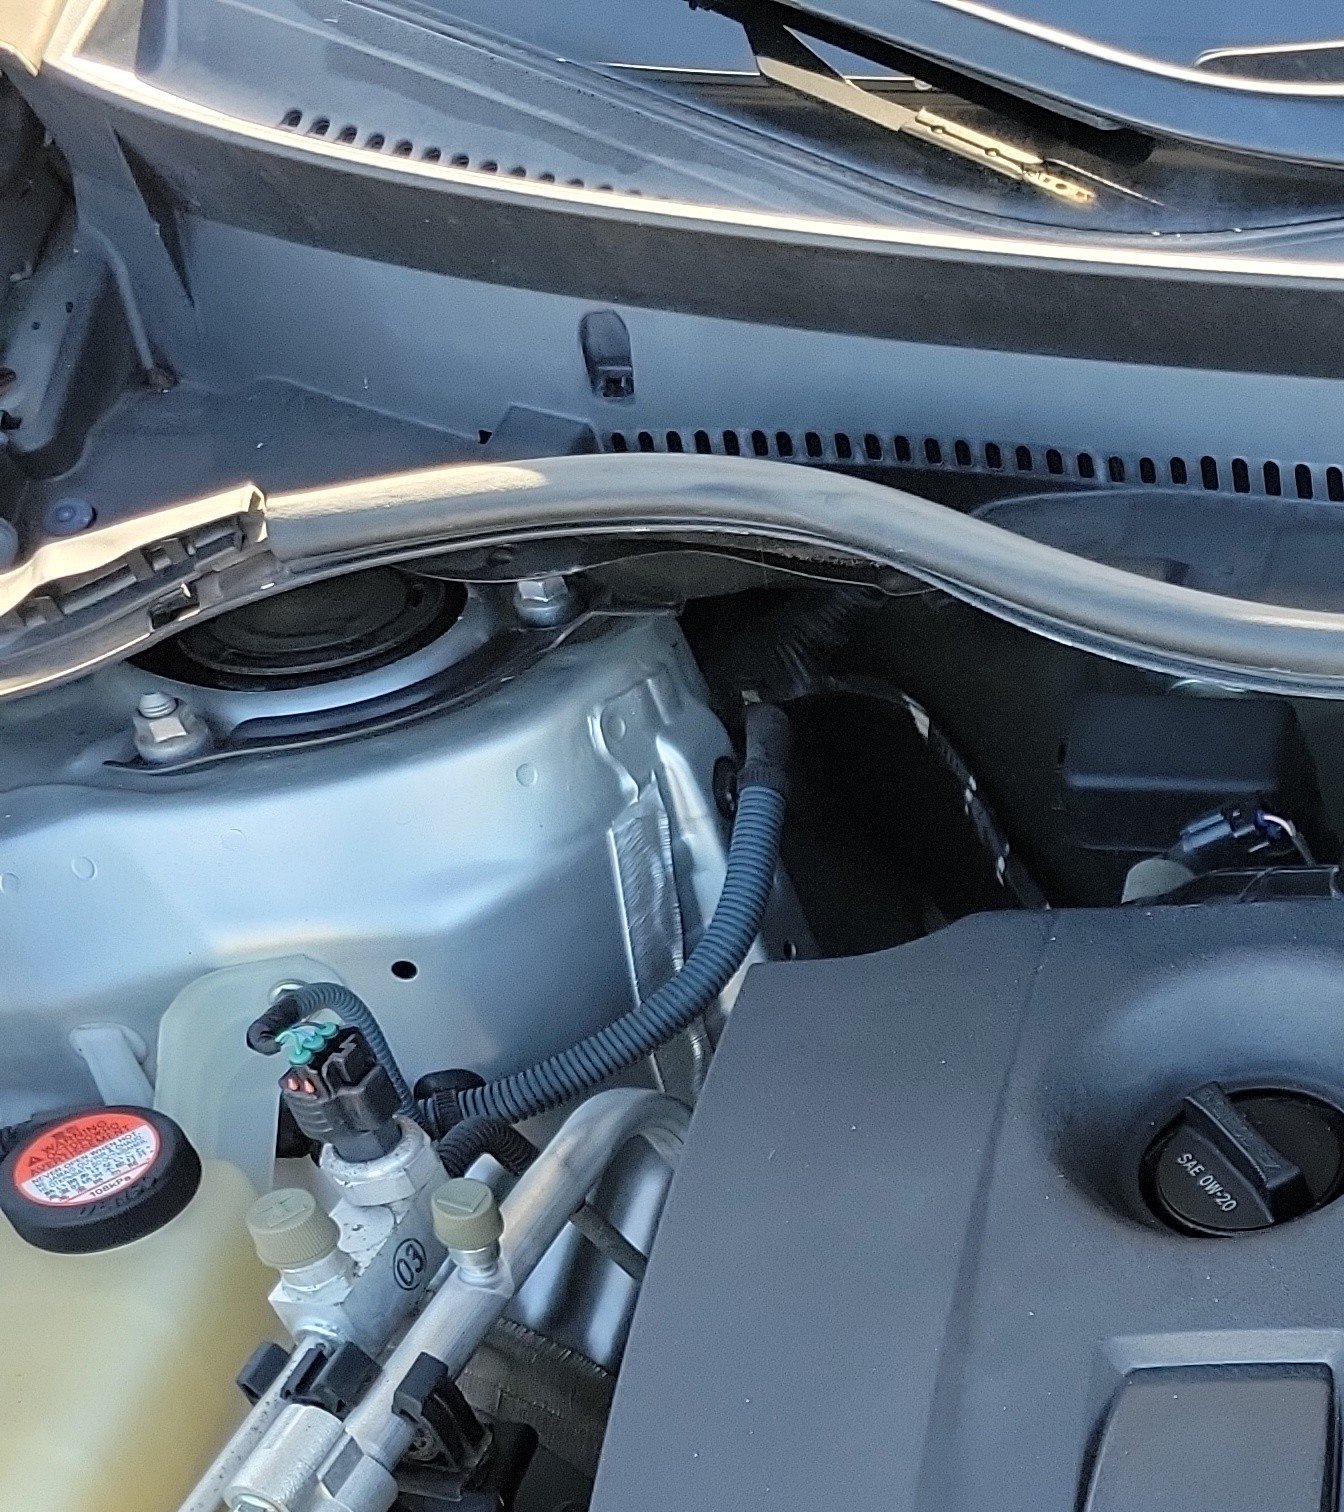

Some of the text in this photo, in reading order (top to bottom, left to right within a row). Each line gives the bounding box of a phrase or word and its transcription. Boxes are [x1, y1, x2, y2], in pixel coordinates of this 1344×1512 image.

[42, 1120, 107, 1153] WARNING
[90, 1175, 132, 1198] 108kPa
[1176, 1152, 1239, 1213] SAE 0W-20
[396, 1243, 424, 1287] 03
